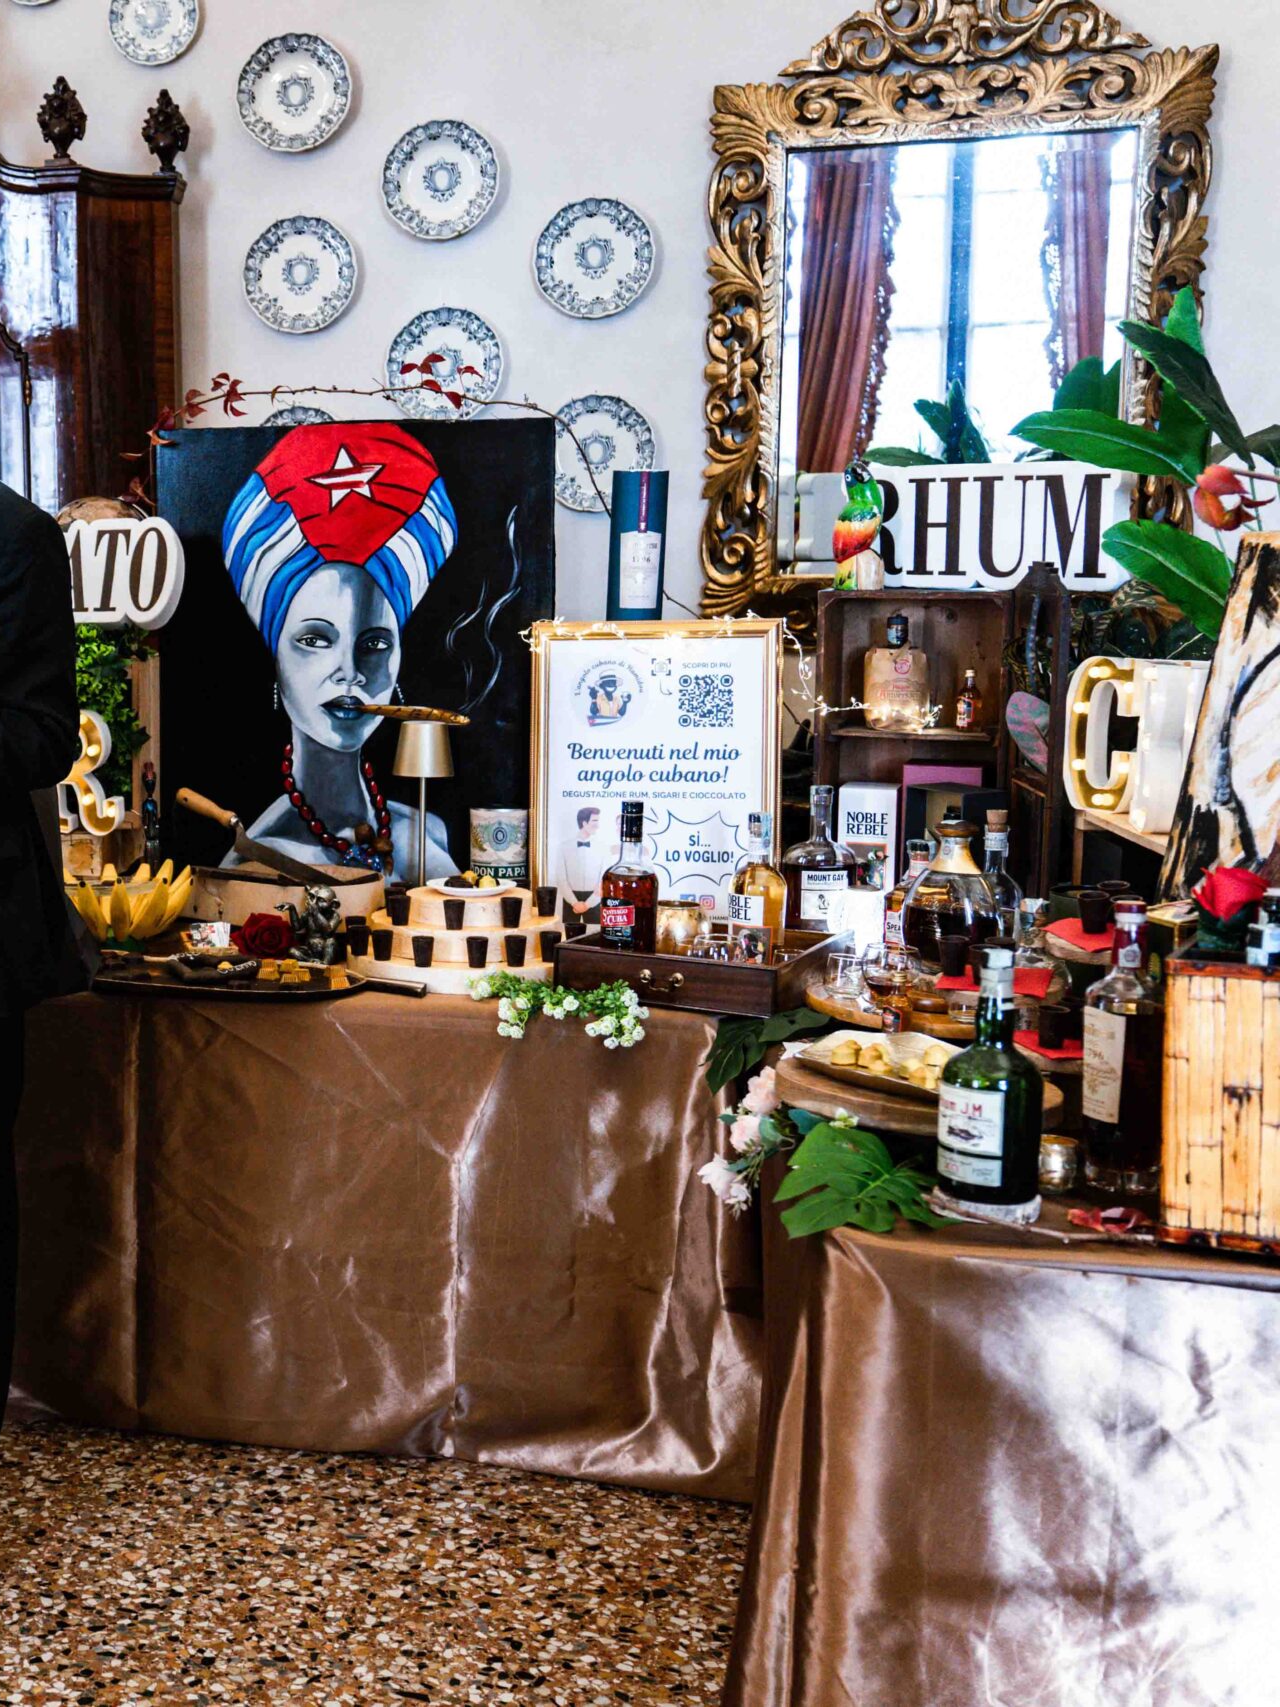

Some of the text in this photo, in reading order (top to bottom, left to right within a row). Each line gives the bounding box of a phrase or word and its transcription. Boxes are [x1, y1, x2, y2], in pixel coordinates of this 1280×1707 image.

[67, 526, 169, 613] ATO
[567, 741, 742, 761] Benvenuti nel mio
[577, 763, 729, 789] angolo cubano!
[562, 790, 627, 799] DEGUSTAZIONE
[629, 791, 651, 800] RUM,
[652, 791, 680, 799] SIGARI
[689, 792, 746, 800] CIOCCOLATO
[846, 811, 888, 824] NOBLE
[846, 823, 888, 836] REBEL
[665, 849, 734, 864] LO VOGLIO!
[474, 866, 526, 877] DON PAPA
[728, 893, 752, 909] OBLE
[607, 915, 628, 925] CUBA
[728, 906, 751, 921] EBEL
[886, 922, 902, 930] SPEA
